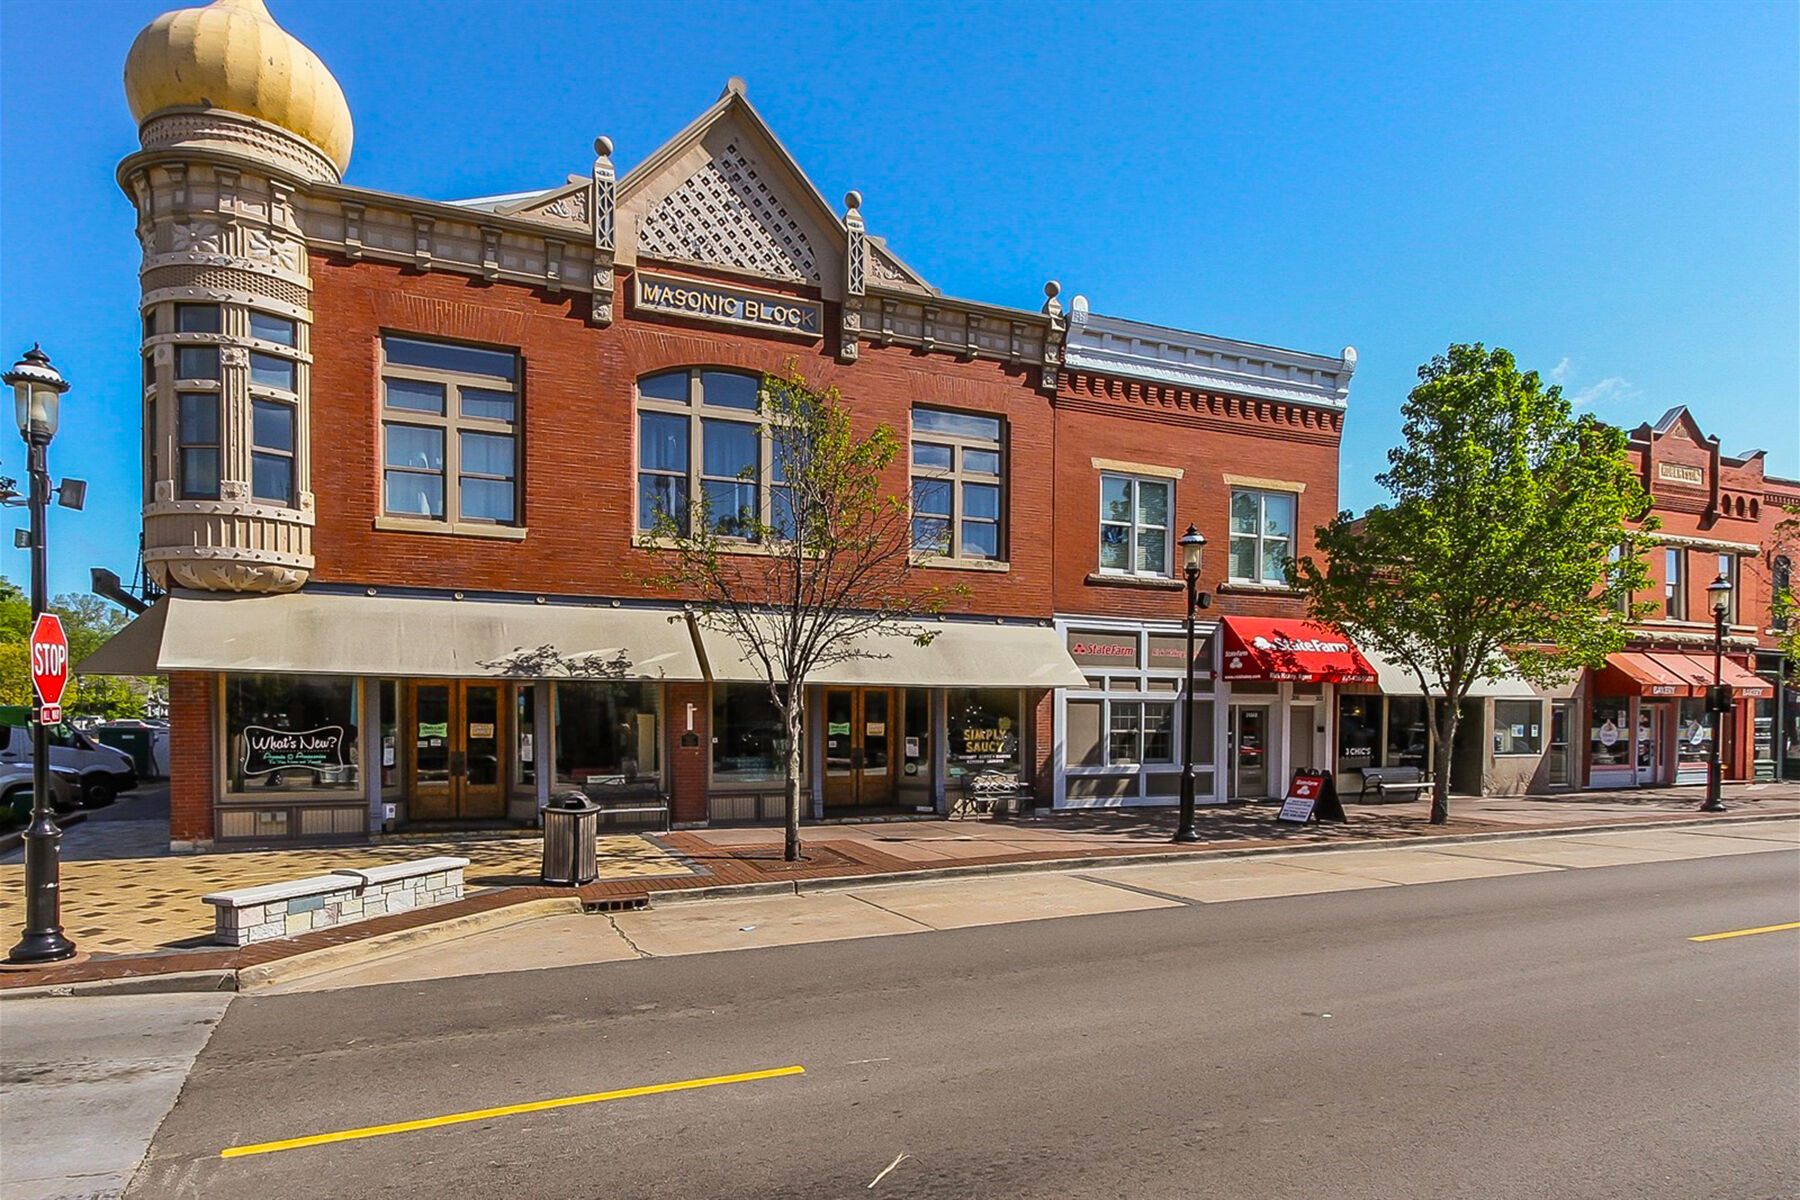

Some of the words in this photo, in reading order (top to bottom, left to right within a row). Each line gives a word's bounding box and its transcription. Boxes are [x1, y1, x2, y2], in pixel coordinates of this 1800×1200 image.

[643, 282, 738, 315] MASONIC
[745, 300, 815, 327] BLOCK
[35, 643, 66, 676] STOP
[252, 735, 297, 750] What's
[299, 735, 338, 749] New?
[963, 729, 1007, 741] SIMPLY
[966, 741, 1005, 752] SAUCY
